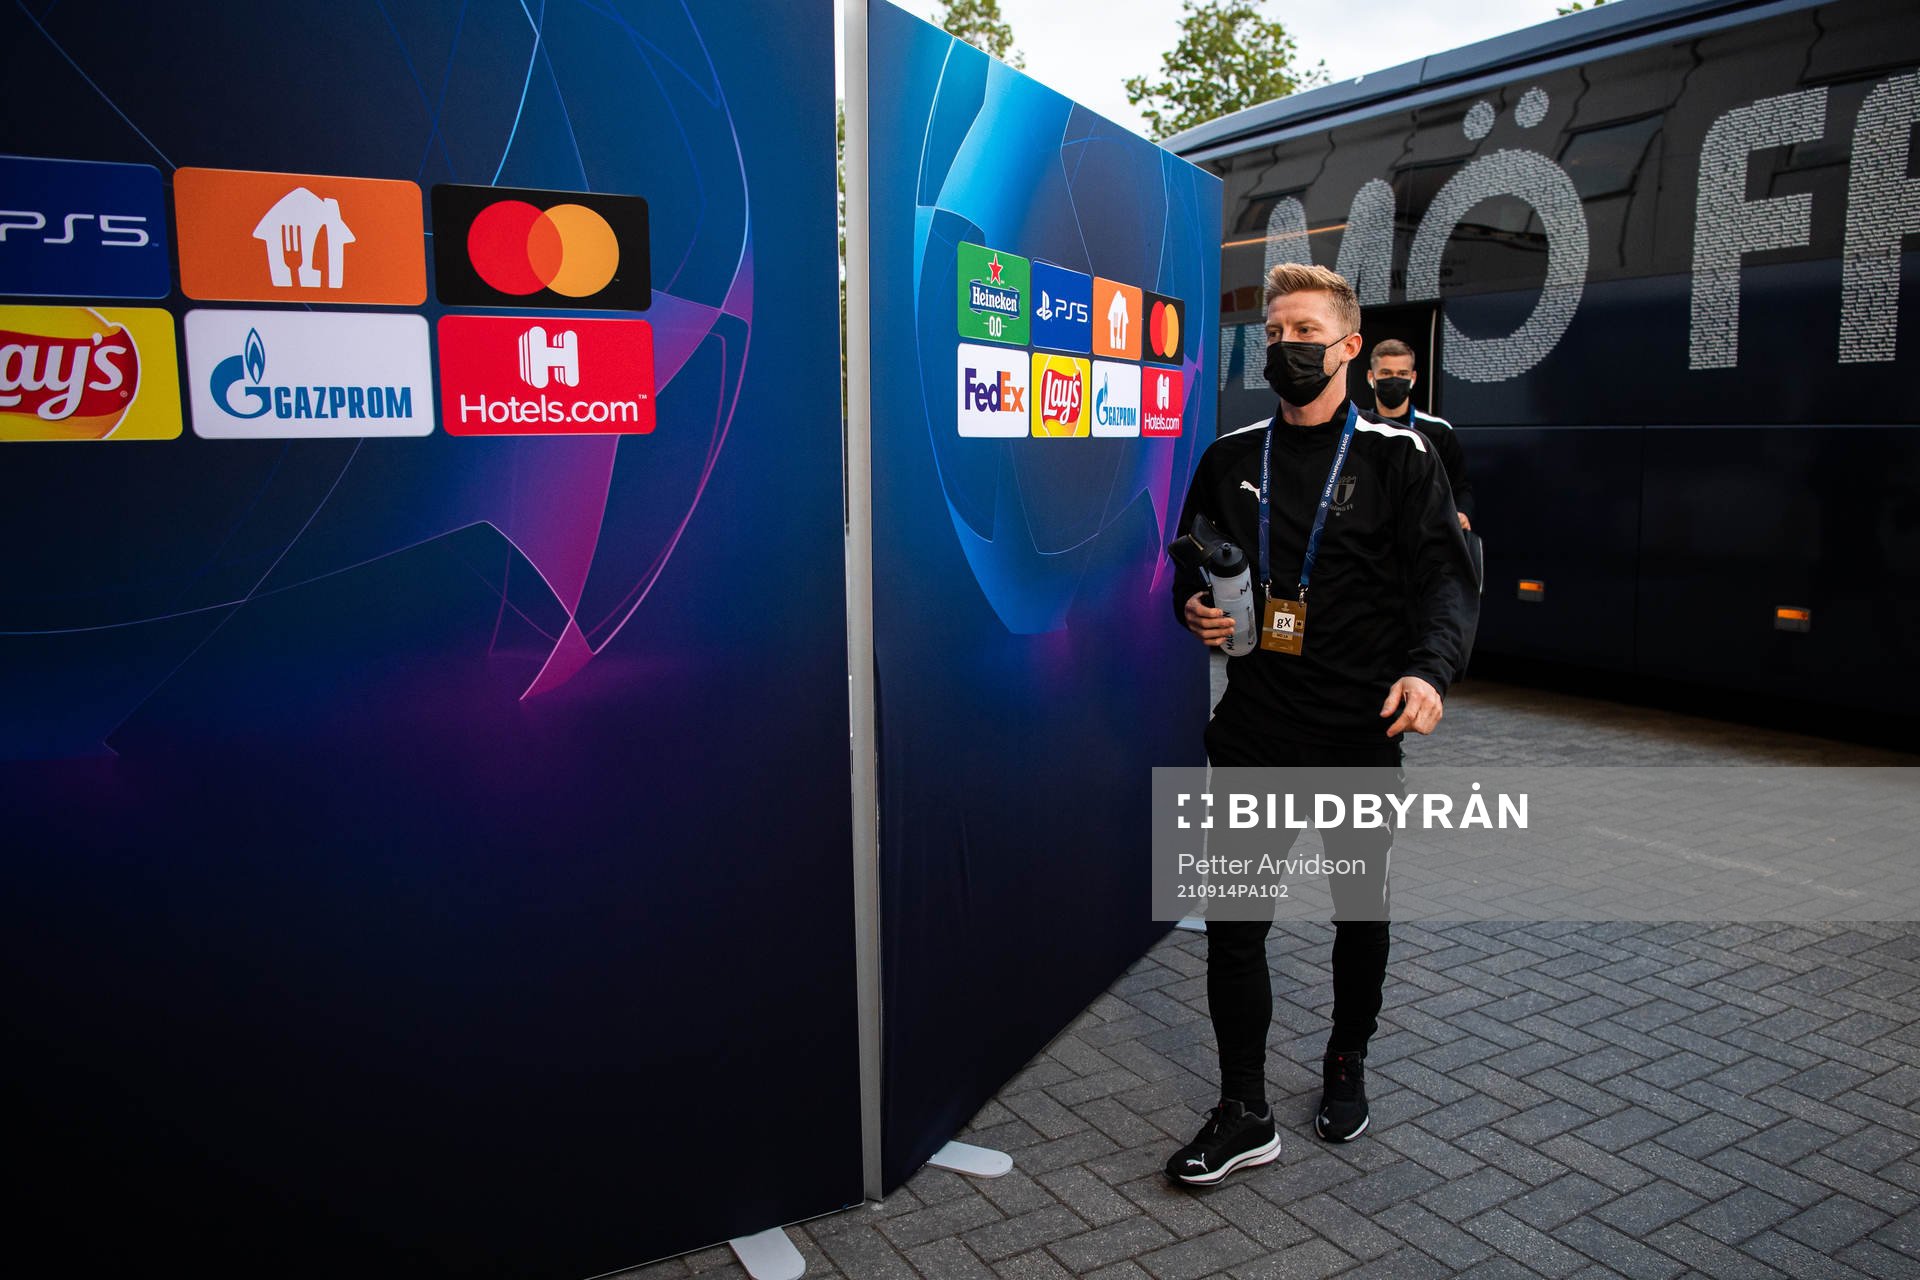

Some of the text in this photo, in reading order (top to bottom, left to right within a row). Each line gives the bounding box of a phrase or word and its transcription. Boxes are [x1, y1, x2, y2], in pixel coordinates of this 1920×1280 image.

[0, 210, 149, 247] PS5
[972, 286, 1018, 312] Heineken
[1055, 298, 1088, 323] PS5
[0, 332, 127, 421] ay's
[965, 367, 1025, 413] FedEx
[274, 386, 413, 419] GAZPROM
[460, 394, 639, 423] Hotels.com
[1044, 371, 1081, 425] Lay's
[1108, 406, 1136, 426] GAZPROM
[1144, 413, 1179, 430] Hotels.com
[1325, 433, 1350, 497] UEFA CHAMPIONS LEAGUE
